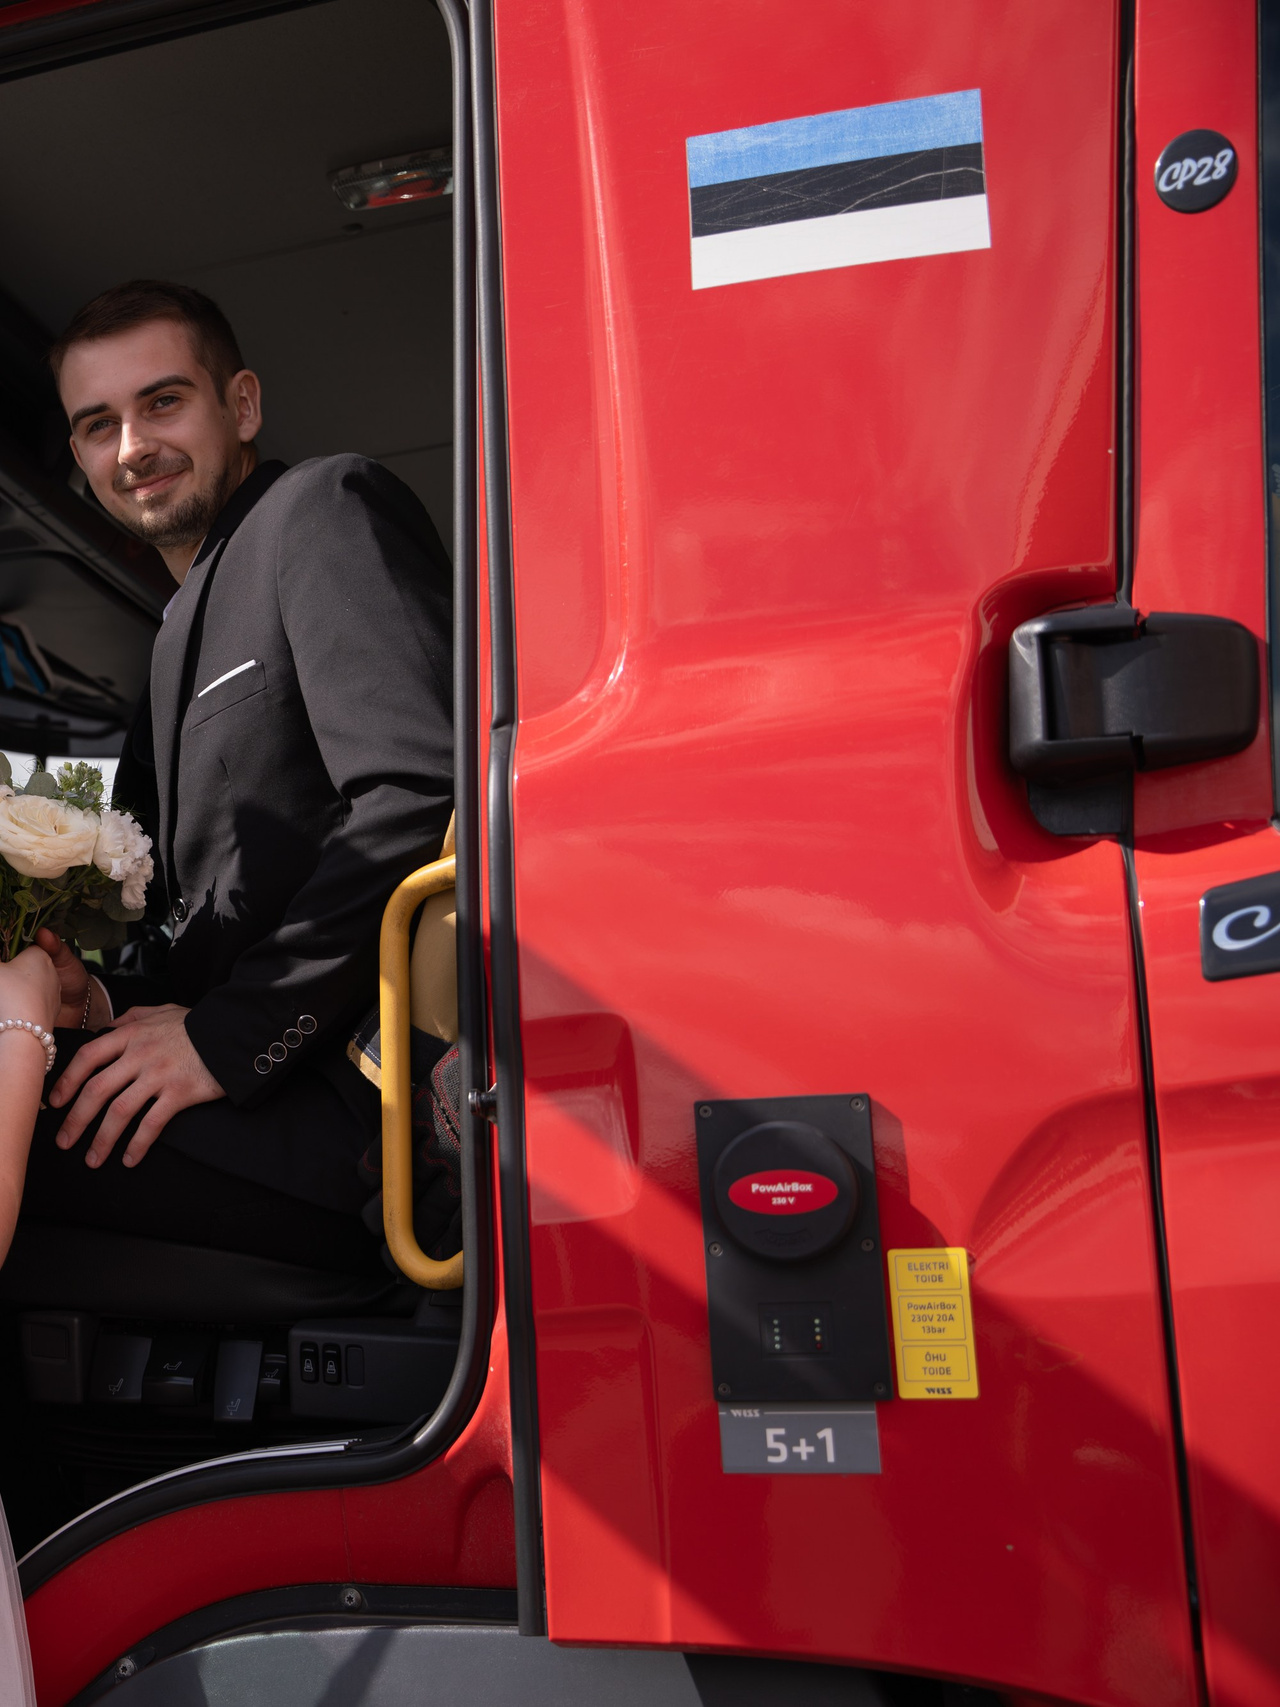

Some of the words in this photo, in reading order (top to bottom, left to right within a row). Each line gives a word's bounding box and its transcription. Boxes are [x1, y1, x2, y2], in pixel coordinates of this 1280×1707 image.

[1158, 147, 1234, 192] CP28
[751, 1182, 813, 1194] PowAirBox
[771, 1196, 787, 1206] 230
[787, 1196, 796, 1205] V
[907, 1261, 950, 1271] ELEKTRI
[915, 1274, 944, 1284] TOIDE
[907, 1302, 957, 1311] PowAirBox
[911, 1313, 934, 1323] 230V
[936, 1313, 955, 1322] 20A
[922, 1325, 946, 1334] 13bar
[922, 1366, 952, 1376] TOIDE
[765, 1427, 836, 1464] 5+1
